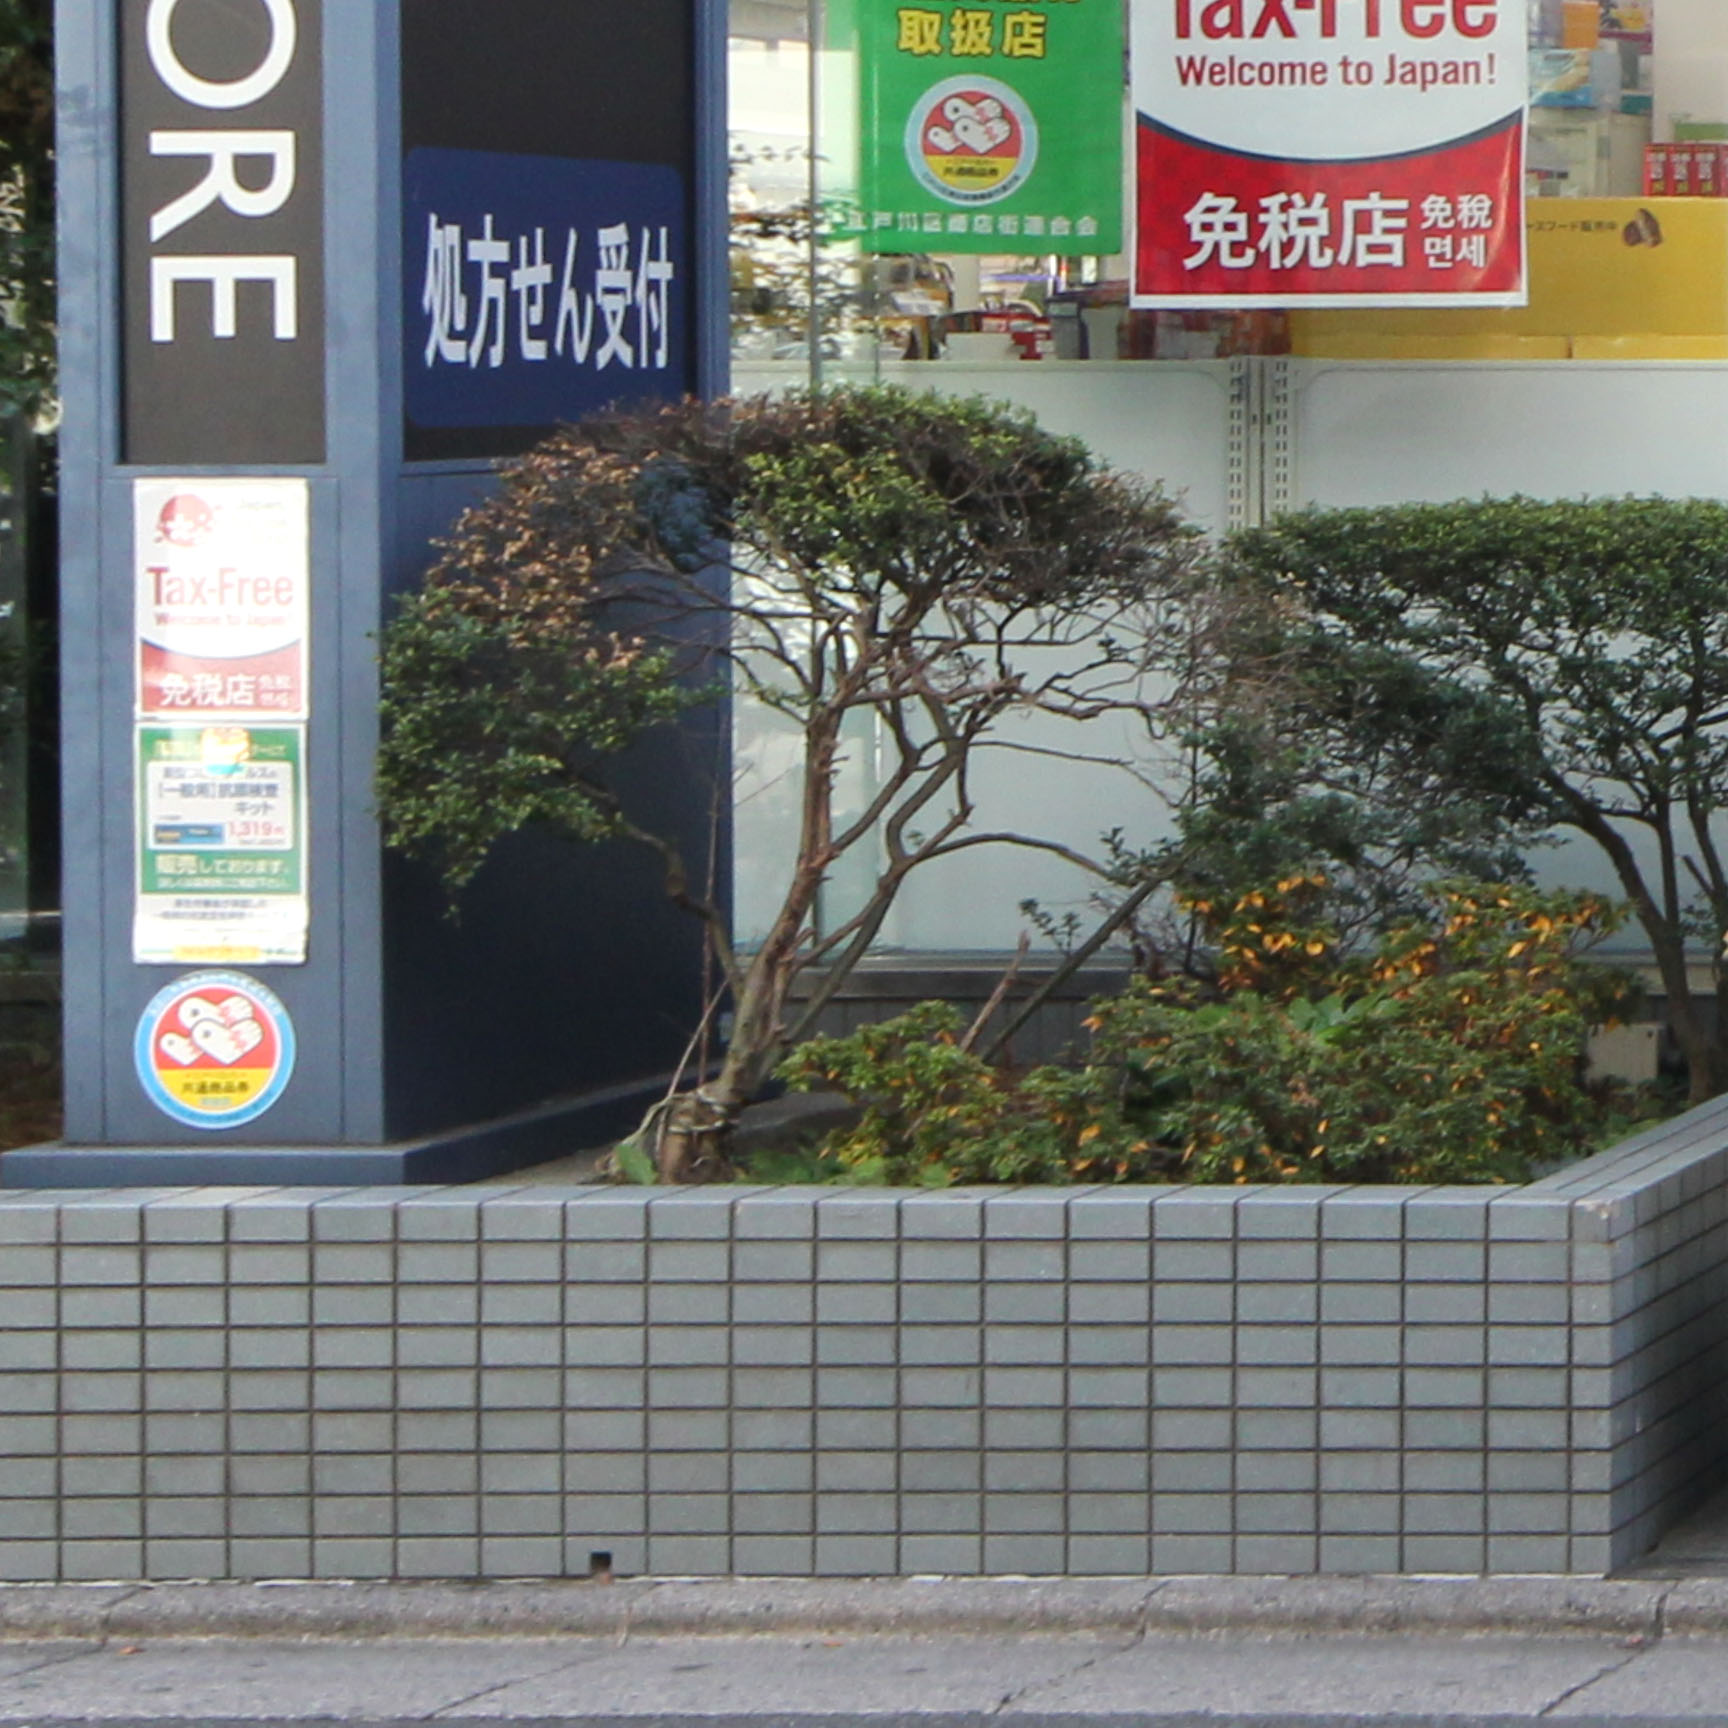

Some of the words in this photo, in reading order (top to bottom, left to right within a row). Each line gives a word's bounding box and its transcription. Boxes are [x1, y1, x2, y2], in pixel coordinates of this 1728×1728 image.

[897, 10, 1047, 59] 取扱店
[1176, 55, 1324, 87] Welcome
[1340, 56, 1371, 87] to
[1383, 54, 1496, 92] Japan!
[1183, 192, 1408, 270] 免税店
[1424, 237, 1487, 270] 면세
[421, 212, 675, 370] 処方せん受付
[147, 567, 294, 607] Tax-Free
